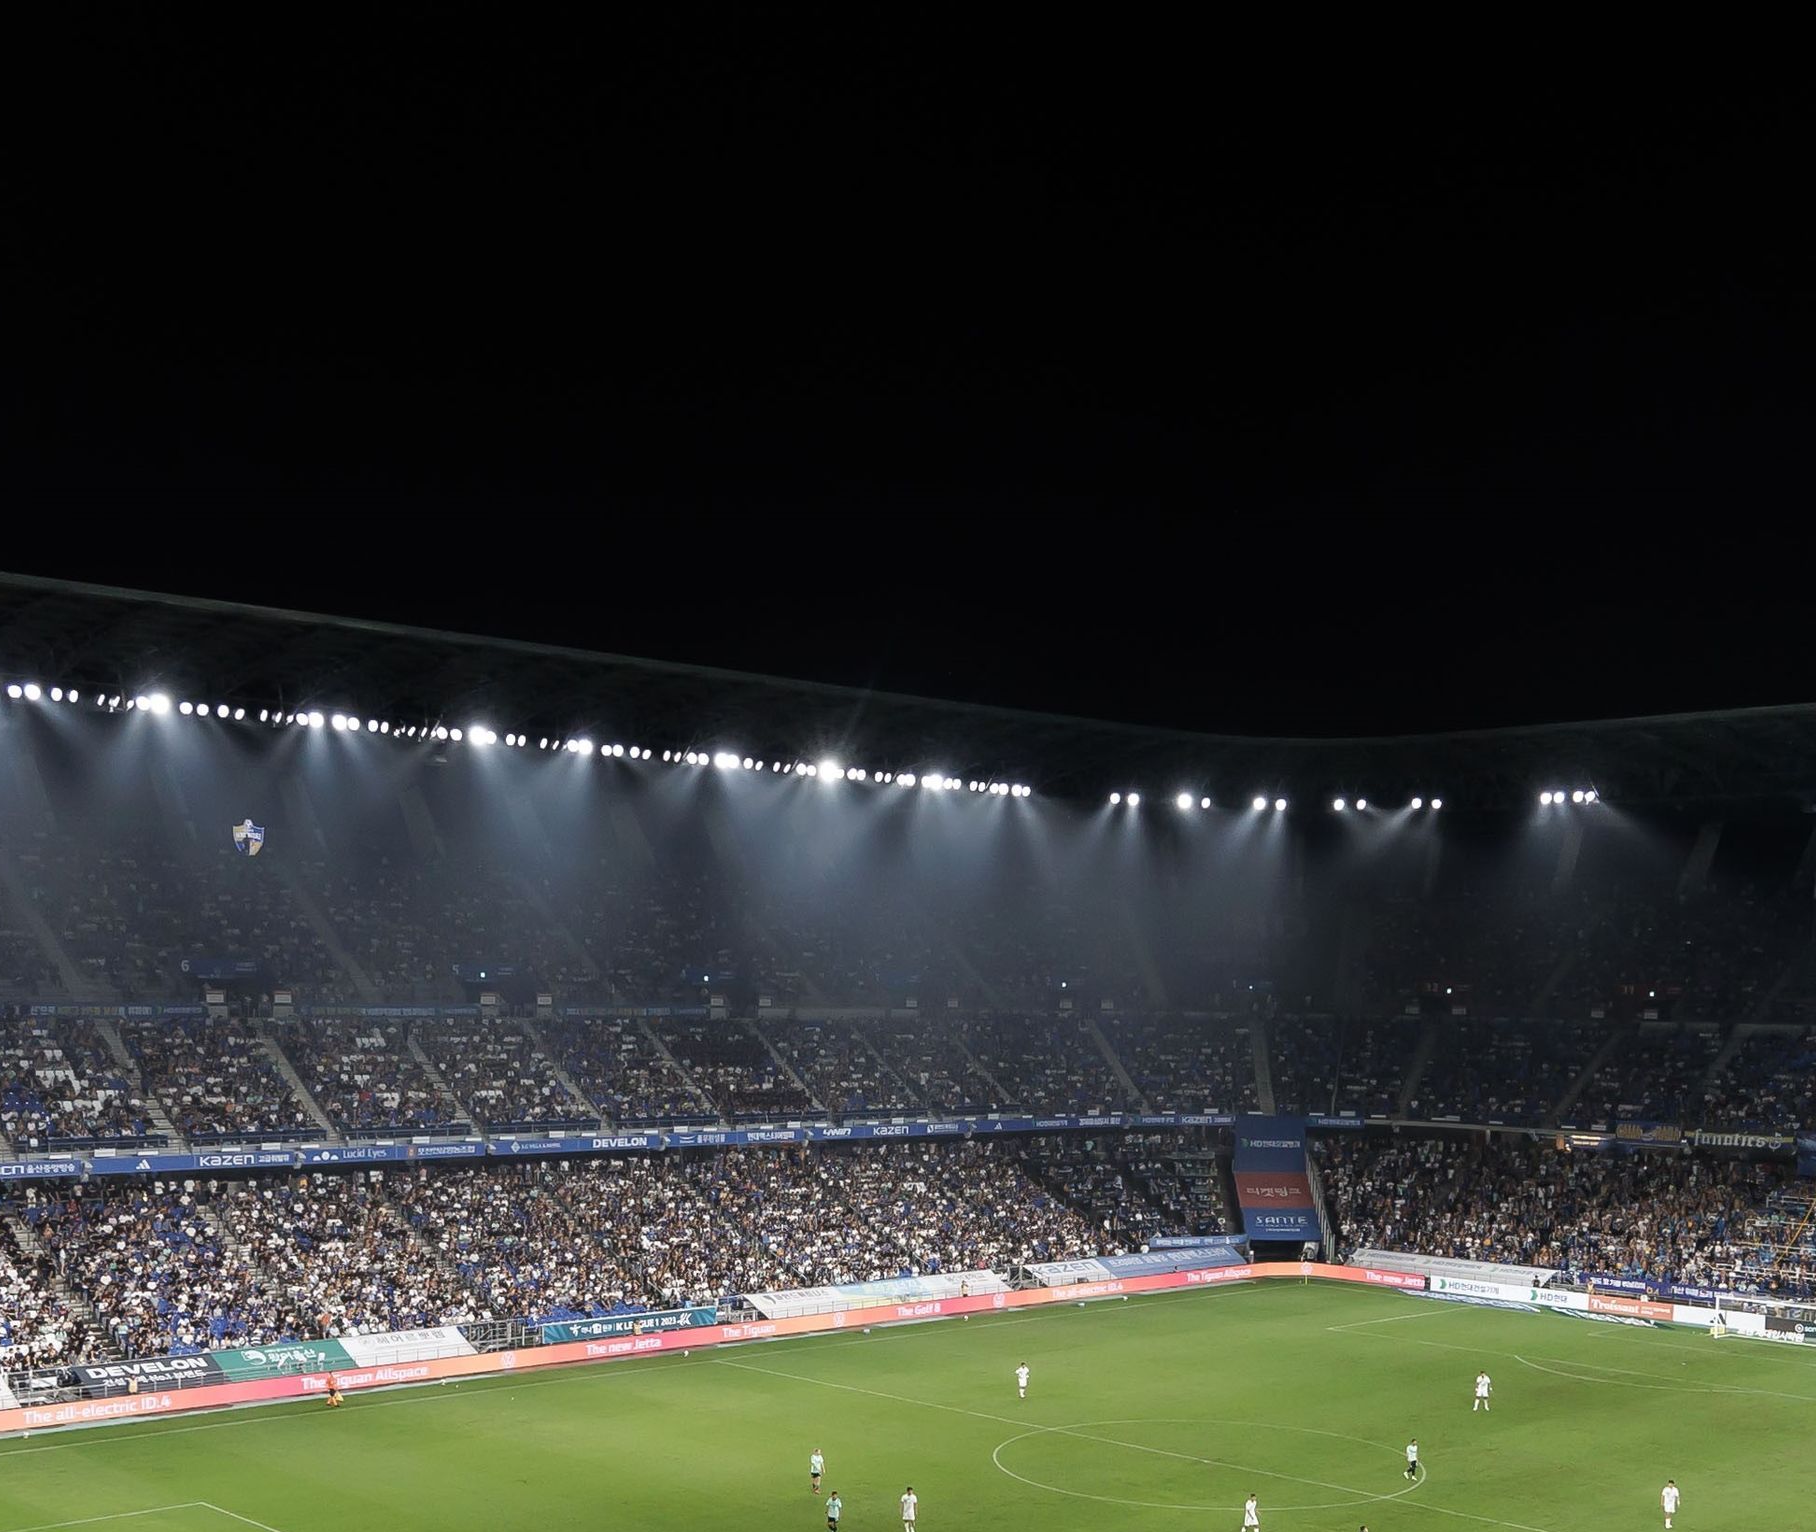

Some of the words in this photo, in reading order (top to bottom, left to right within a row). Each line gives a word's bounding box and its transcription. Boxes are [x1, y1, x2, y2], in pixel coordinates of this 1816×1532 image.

[592, 1136, 648, 1148] DEVELON
[624, 1317, 655, 1331] LEGUE
[660, 1315, 677, 1327] 2023
[722, 1327, 742, 1338] The
[743, 1323, 776, 1339] Tiguan
[585, 1343, 608, 1356] The
[609, 1341, 632, 1353] new
[633, 1336, 663, 1350] Jetta
[85, 1356, 209, 1380] DEVELON
[300, 1375, 325, 1390] The
[375, 1364, 429, 1383] Allspace
[23, 1409, 53, 1425] The
[55, 1398, 138, 1421] all-electric
[140, 1395, 172, 1412] ID.4
